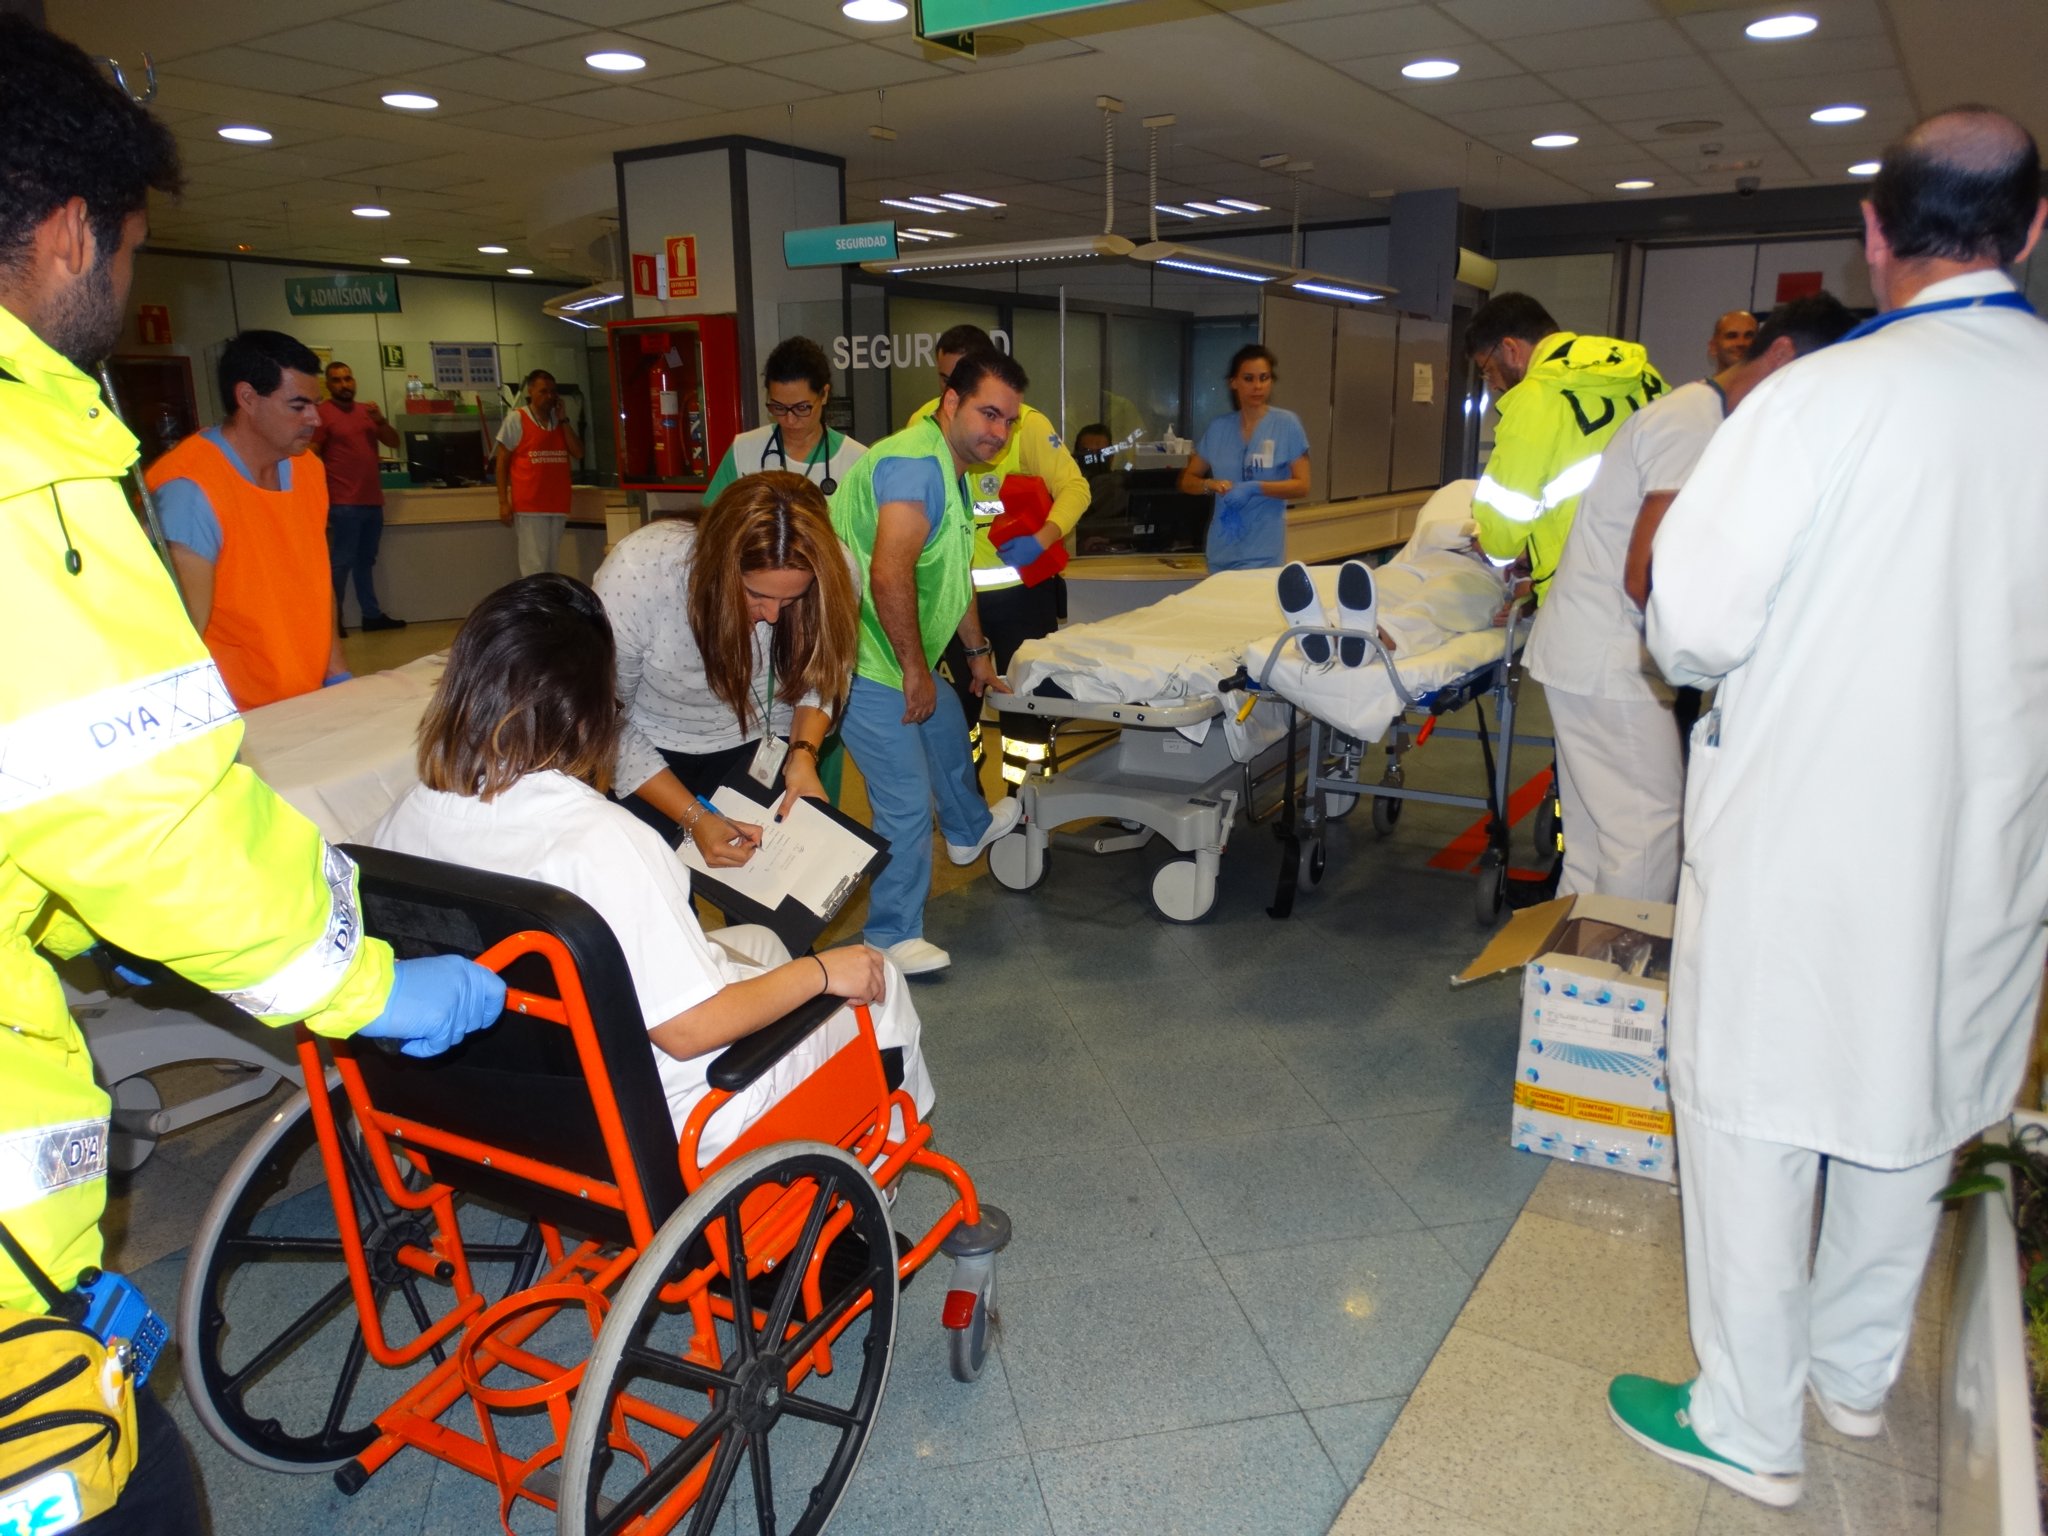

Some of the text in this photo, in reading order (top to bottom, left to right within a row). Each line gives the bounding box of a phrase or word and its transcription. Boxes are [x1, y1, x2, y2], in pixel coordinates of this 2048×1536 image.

[835, 235, 887, 250] SEGURIDAD
[310, 282, 373, 307] ADMISIÓN
[833, 330, 1010, 370] SEGURD
[89, 705, 161, 748] DYA
[333, 900, 354, 953] DYA
[70, 1136, 98, 1167] DYA
